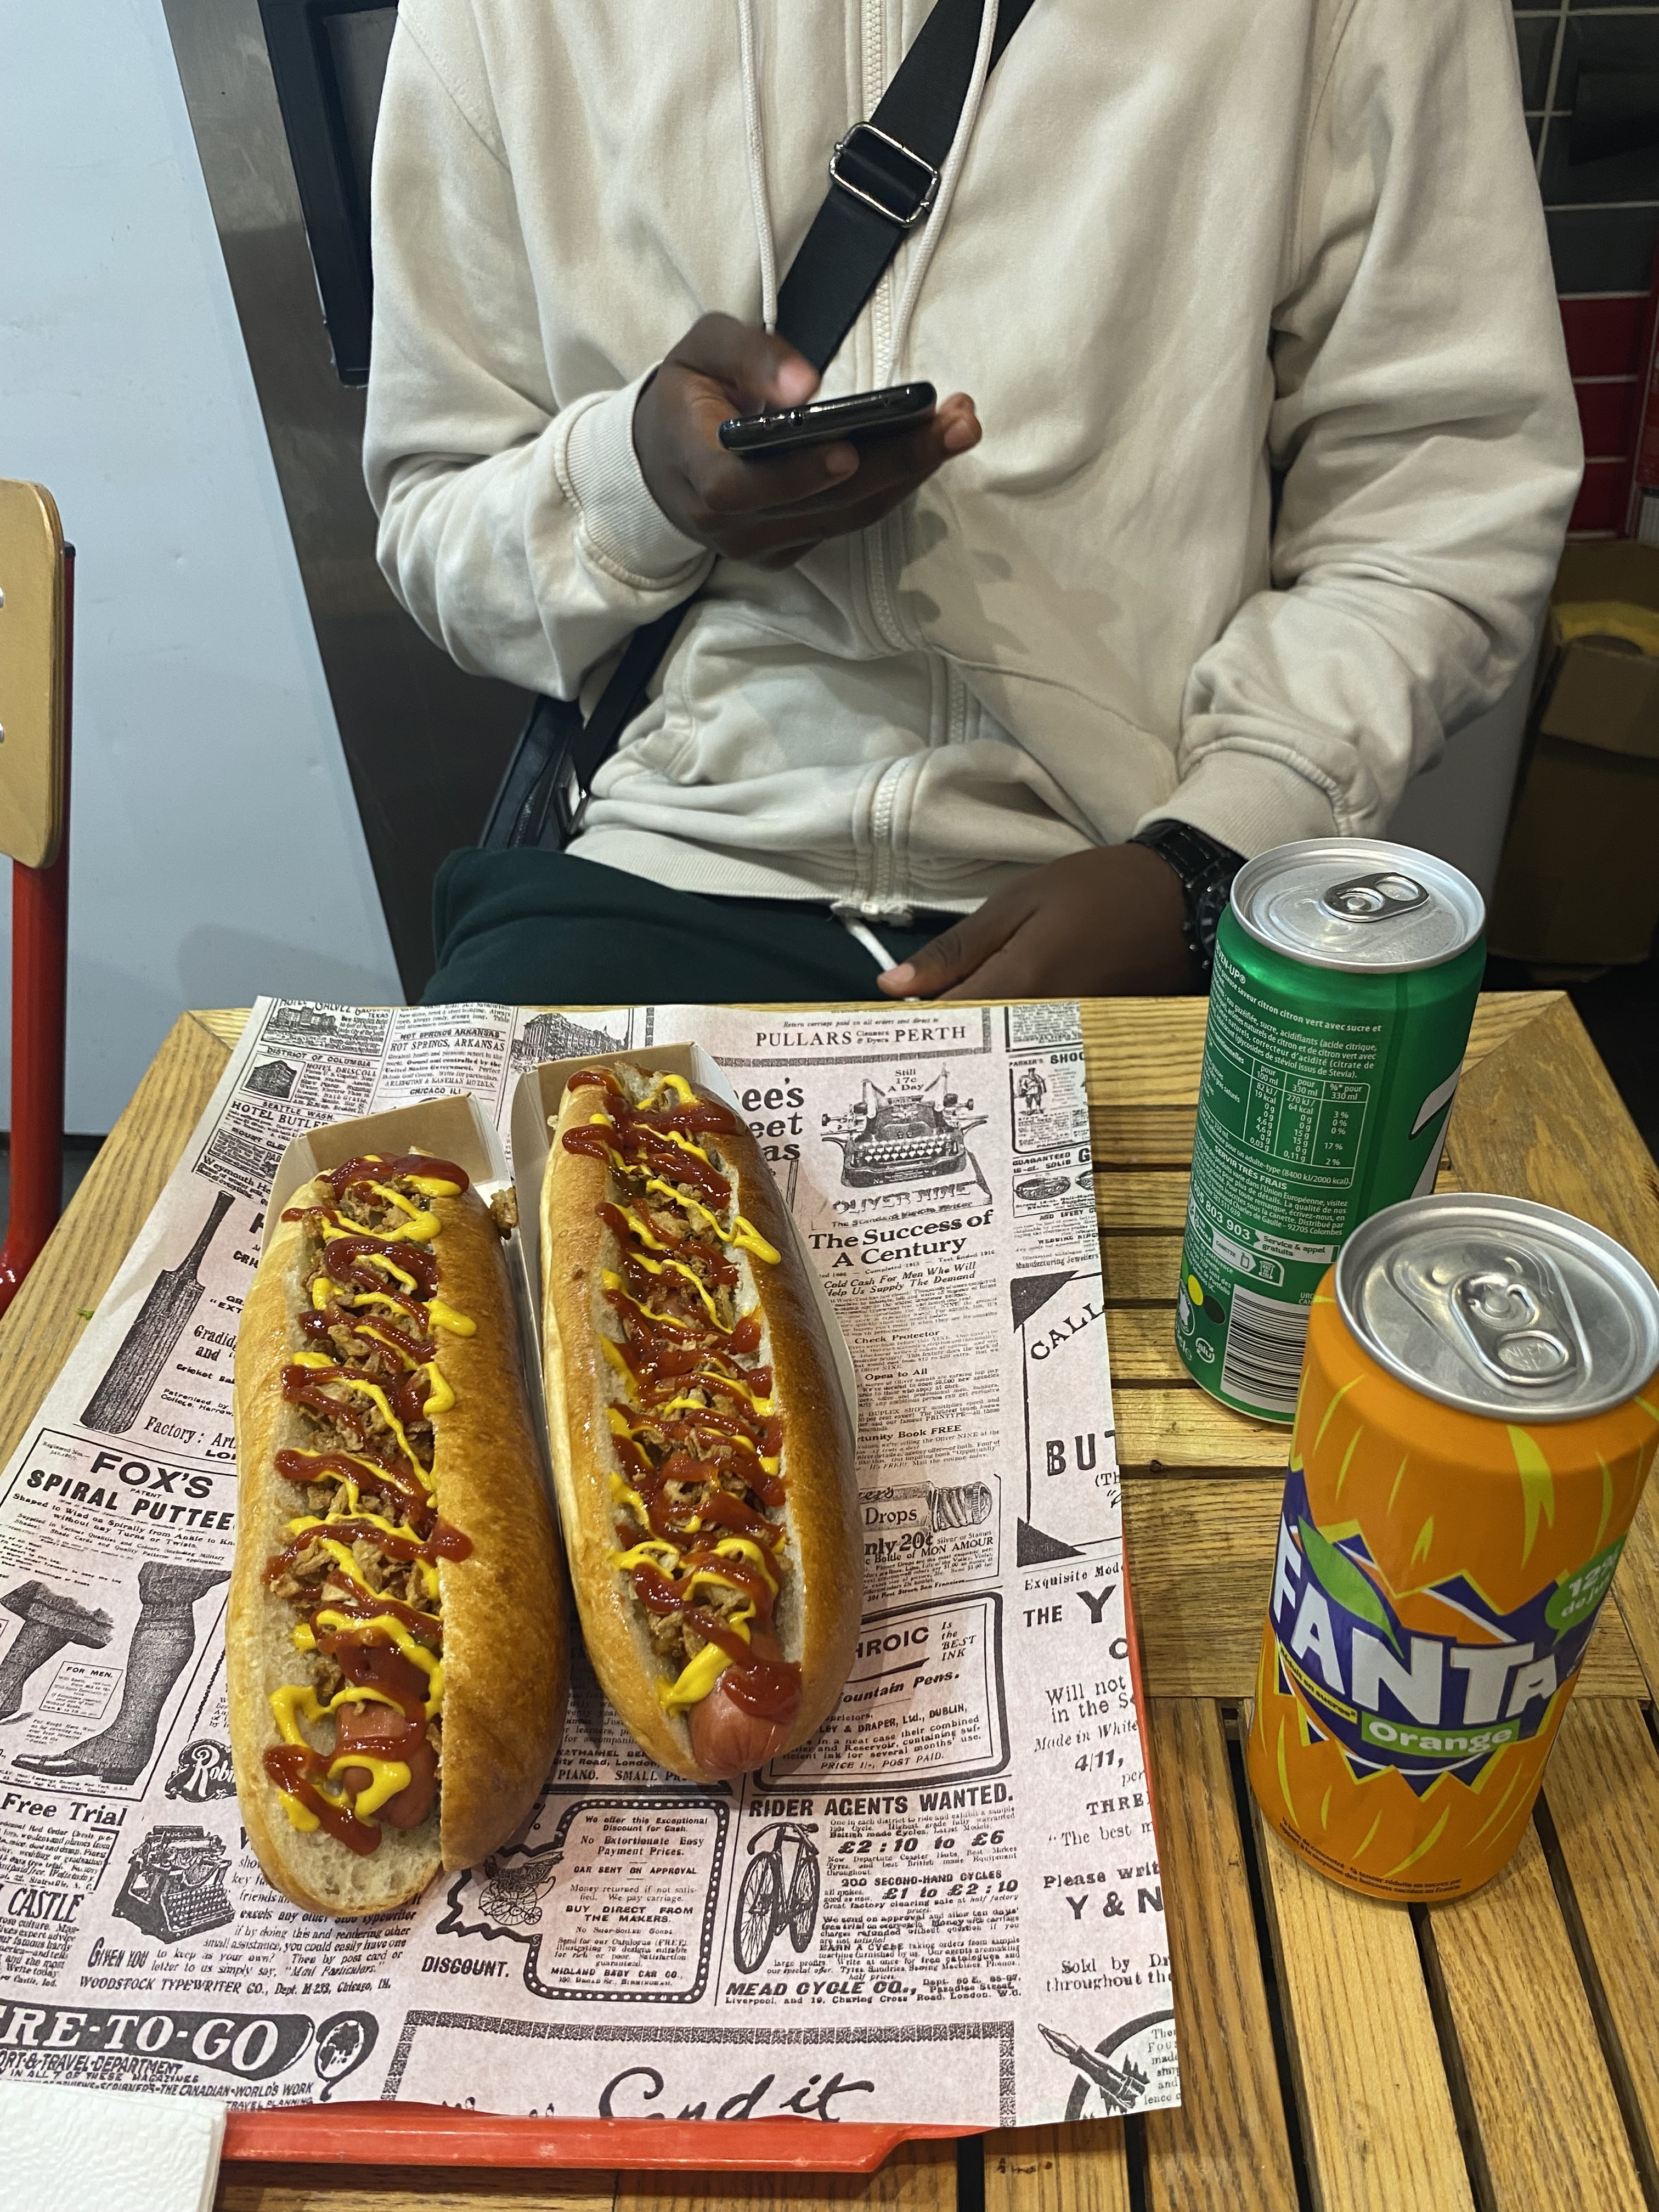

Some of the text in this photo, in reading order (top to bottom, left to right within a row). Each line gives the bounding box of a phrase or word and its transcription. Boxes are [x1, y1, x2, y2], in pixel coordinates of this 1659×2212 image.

[1238, 987, 1257, 1006] saveur
[1257, 1000, 1278, 1014] citron
[1279, 1010, 1303, 1023] citron
[1306, 1018, 1322, 1027] vert
[1325, 1023, 1345, 1031] avec
[455, 1039, 505, 1051] ARKANSAS
[756, 1026, 966, 1046] PULLARS PERTH
[1261, 1021, 1376, 1052] sucre, acidifiants (acide citrique,
[895, 1069, 916, 1077] Still
[1257, 1072, 1267, 1081] 100
[1261, 1065, 1276, 1076] pour
[733, 1077, 804, 1112] ee's
[901, 1083, 924, 1091] Day
[231, 1101, 274, 1120] HOTEL
[263, 1102, 301, 1114] SEATTLE
[1215, 1146, 1287, 1189] SERVIR TRÈS FRAIS
[1206, 1200, 1223, 1224] 803
[1226, 1221, 1251, 1239] 903
[809, 1210, 994, 1249] The Success of
[1288, 1225, 1308, 1233] 92705
[1262, 1244, 1294, 1256] gratuits
[1264, 1236, 1293, 1249] Service
[832, 1238, 967, 1267] A Century
[824, 1280, 847, 1289] Cold
[851, 1278, 874, 1287] Cash
[880, 1275, 897, 1283] For
[928, 1266, 950, 1275] Who
[954, 1262, 976, 1271] Will
[872, 1283, 904, 1294] Supply
[934, 1272, 975, 1283] Demand
[855, 1330, 940, 1344] Check Protector
[195, 1346, 221, 1361] and
[144, 1416, 197, 1443] Factory
[899, 1425, 961, 1438] Book FREE
[1047, 1430, 1115, 1476] BU
[91, 1452, 213, 1499] FOX'S
[27, 1470, 235, 1530] SPIRAL PUTTEE
[131, 1488, 162, 1499] PATENT
[866, 1507, 917, 1525] Drops
[875, 1537, 993, 1563] Bottle of MON AMOUR
[1023, 1605, 1062, 1627] THE
[1273, 1513, 1558, 1725] FANTA
[941, 1630, 957, 1639] the
[942, 1635, 977, 1650] BEST
[941, 1648, 966, 1661] INK
[66, 1666, 86, 1674] FOR
[913, 1672, 959, 1688] Pens.
[1045, 1675, 1126, 1705] Will not
[1369, 1722, 1512, 1754] Orange
[749, 1783, 1013, 1816] RIDER AGENTS WANTED.
[1, 1793, 127, 1826] Free Trial
[1101, 1824, 1131, 1839] best
[581, 1836, 594, 1844] No
[680, 1838, 704, 1846] Easy
[838, 1841, 871, 1854] £2
[894, 1838, 918, 1852] 10
[934, 1836, 955, 1848] to
[971, 1830, 1005, 1845] £6
[597, 1846, 684, 1856] Payment Prices.
[875, 1874, 953, 1886] SECOND-HAND
[960, 1871, 1002, 1881] CYCLES
[1043, 1872, 1105, 1888] Please
[883, 1888, 907, 1899] £1
[920, 1886, 936, 1897] to
[947, 1883, 979, 1895] £2
[998, 1880, 1018, 1893] 10
[8, 1892, 84, 1922] CASTLE
[422, 1956, 510, 1977] DISCOUNT.
[1062, 1956, 1129, 1973] Sold by
[80, 1976, 156, 1990] WOODSTOCK
[161, 1978, 242, 1994] TYPEWRITER
[726, 1983, 787, 1995] MEAD
[797, 1982, 862, 1995] CYCLE
[1047, 1971, 1141, 1991] throughout
